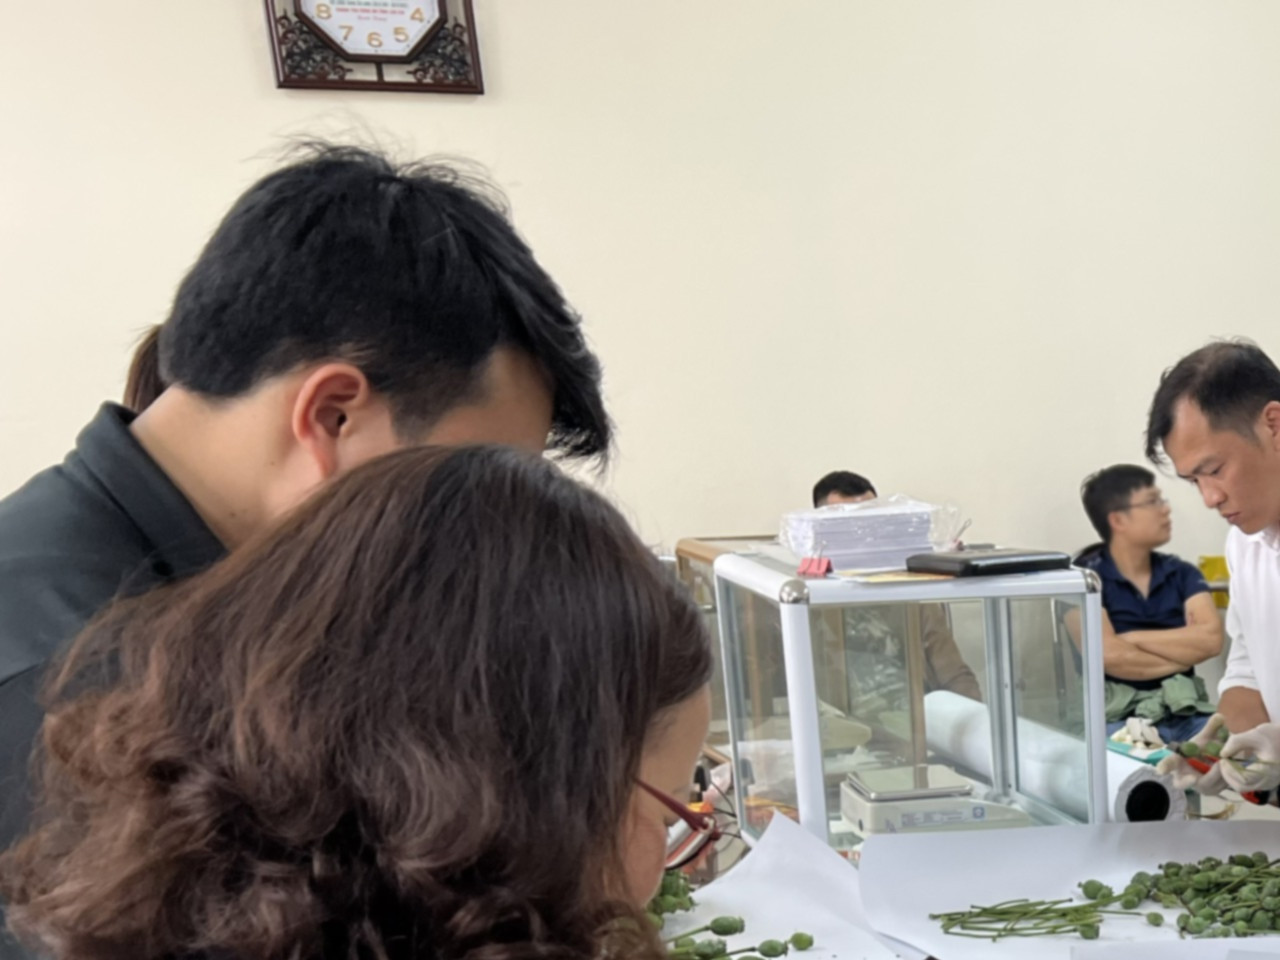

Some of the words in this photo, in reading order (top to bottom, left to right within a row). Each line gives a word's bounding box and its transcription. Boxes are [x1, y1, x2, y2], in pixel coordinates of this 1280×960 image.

[316, 3, 332, 20] 8
[410, 7, 424, 22] 4
[338, 25, 354, 41] 7
[366, 31, 384, 48] 6
[393, 26, 409, 43] 5
